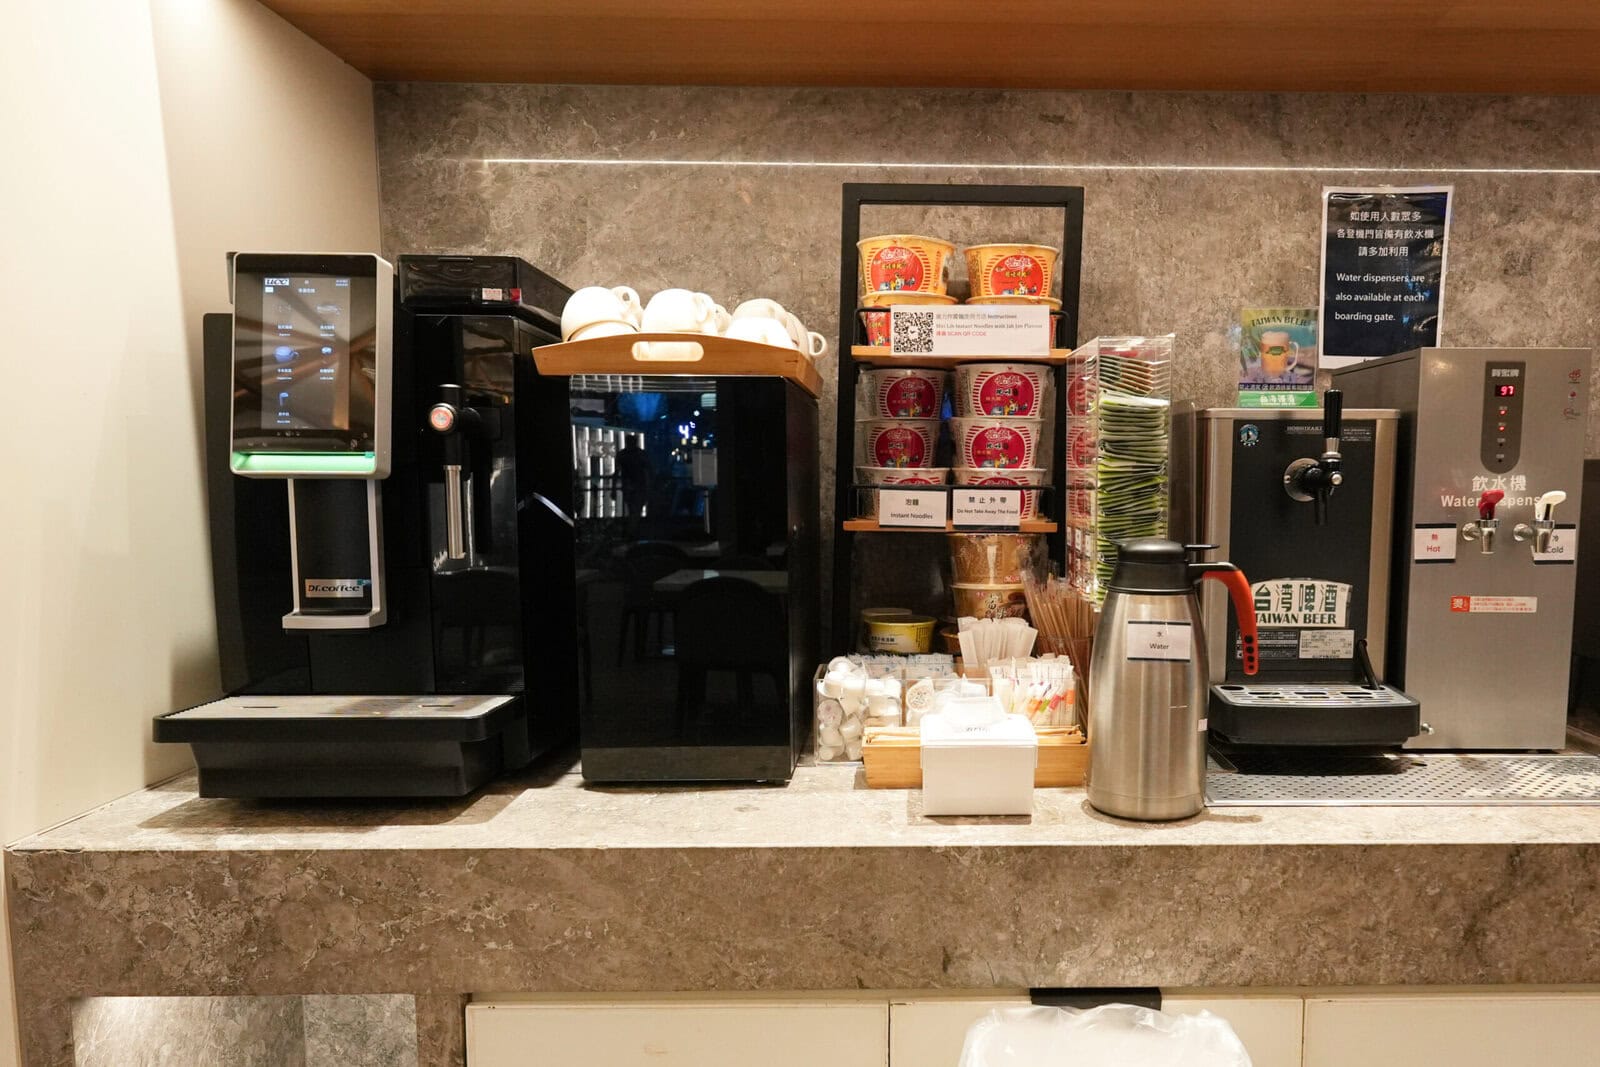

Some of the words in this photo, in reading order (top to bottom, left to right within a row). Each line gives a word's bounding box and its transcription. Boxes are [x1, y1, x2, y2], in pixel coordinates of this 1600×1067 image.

[1350, 211, 1421, 221] 如使用人數眾多
[1336, 228, 1434, 239] 各登機門皆備有飲水機
[1358, 246, 1409, 257] 請多加利用
[1336, 273, 1361, 282] Water
[1363, 273, 1409, 284] dispensers
[1335, 292, 1352, 301] also
[1354, 293, 1391, 302] available
[1393, 294, 1402, 302] at
[1403, 292, 1425, 302] each
[1251, 316, 1282, 327] TAIWAN
[1335, 312, 1372, 322] boarding
[1374, 313, 1396, 323] gate.
[1500, 385, 1514, 396] 97
[1472, 475, 1527, 492] 飲水機
[1440, 495, 1482, 508] Water
[1426, 545, 1441, 553] Hot
[307, 584, 360, 592] Dr.coffee
[1255, 613, 1299, 624] TAIWAN
[1303, 613, 1337, 624] BEER
[1149, 642, 1169, 650] Water
